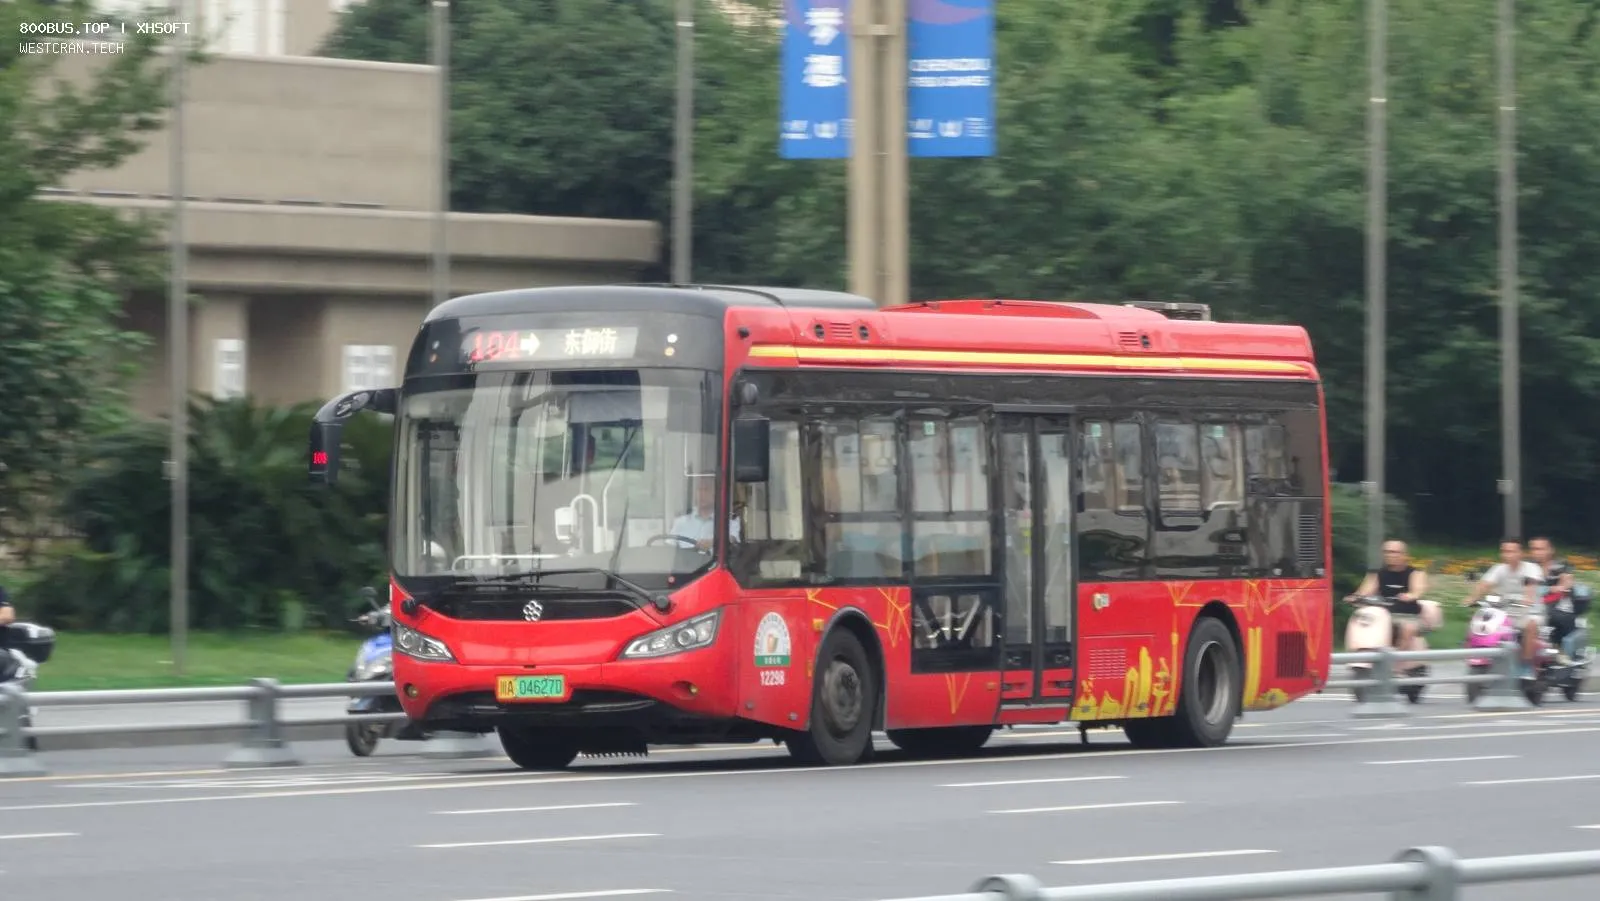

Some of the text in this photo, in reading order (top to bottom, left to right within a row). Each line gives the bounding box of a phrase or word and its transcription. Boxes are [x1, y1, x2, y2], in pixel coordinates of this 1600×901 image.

[471, 331, 521, 361] 104
[759, 670, 785, 686] 12298
[519, 679, 562, 695] 04627D
